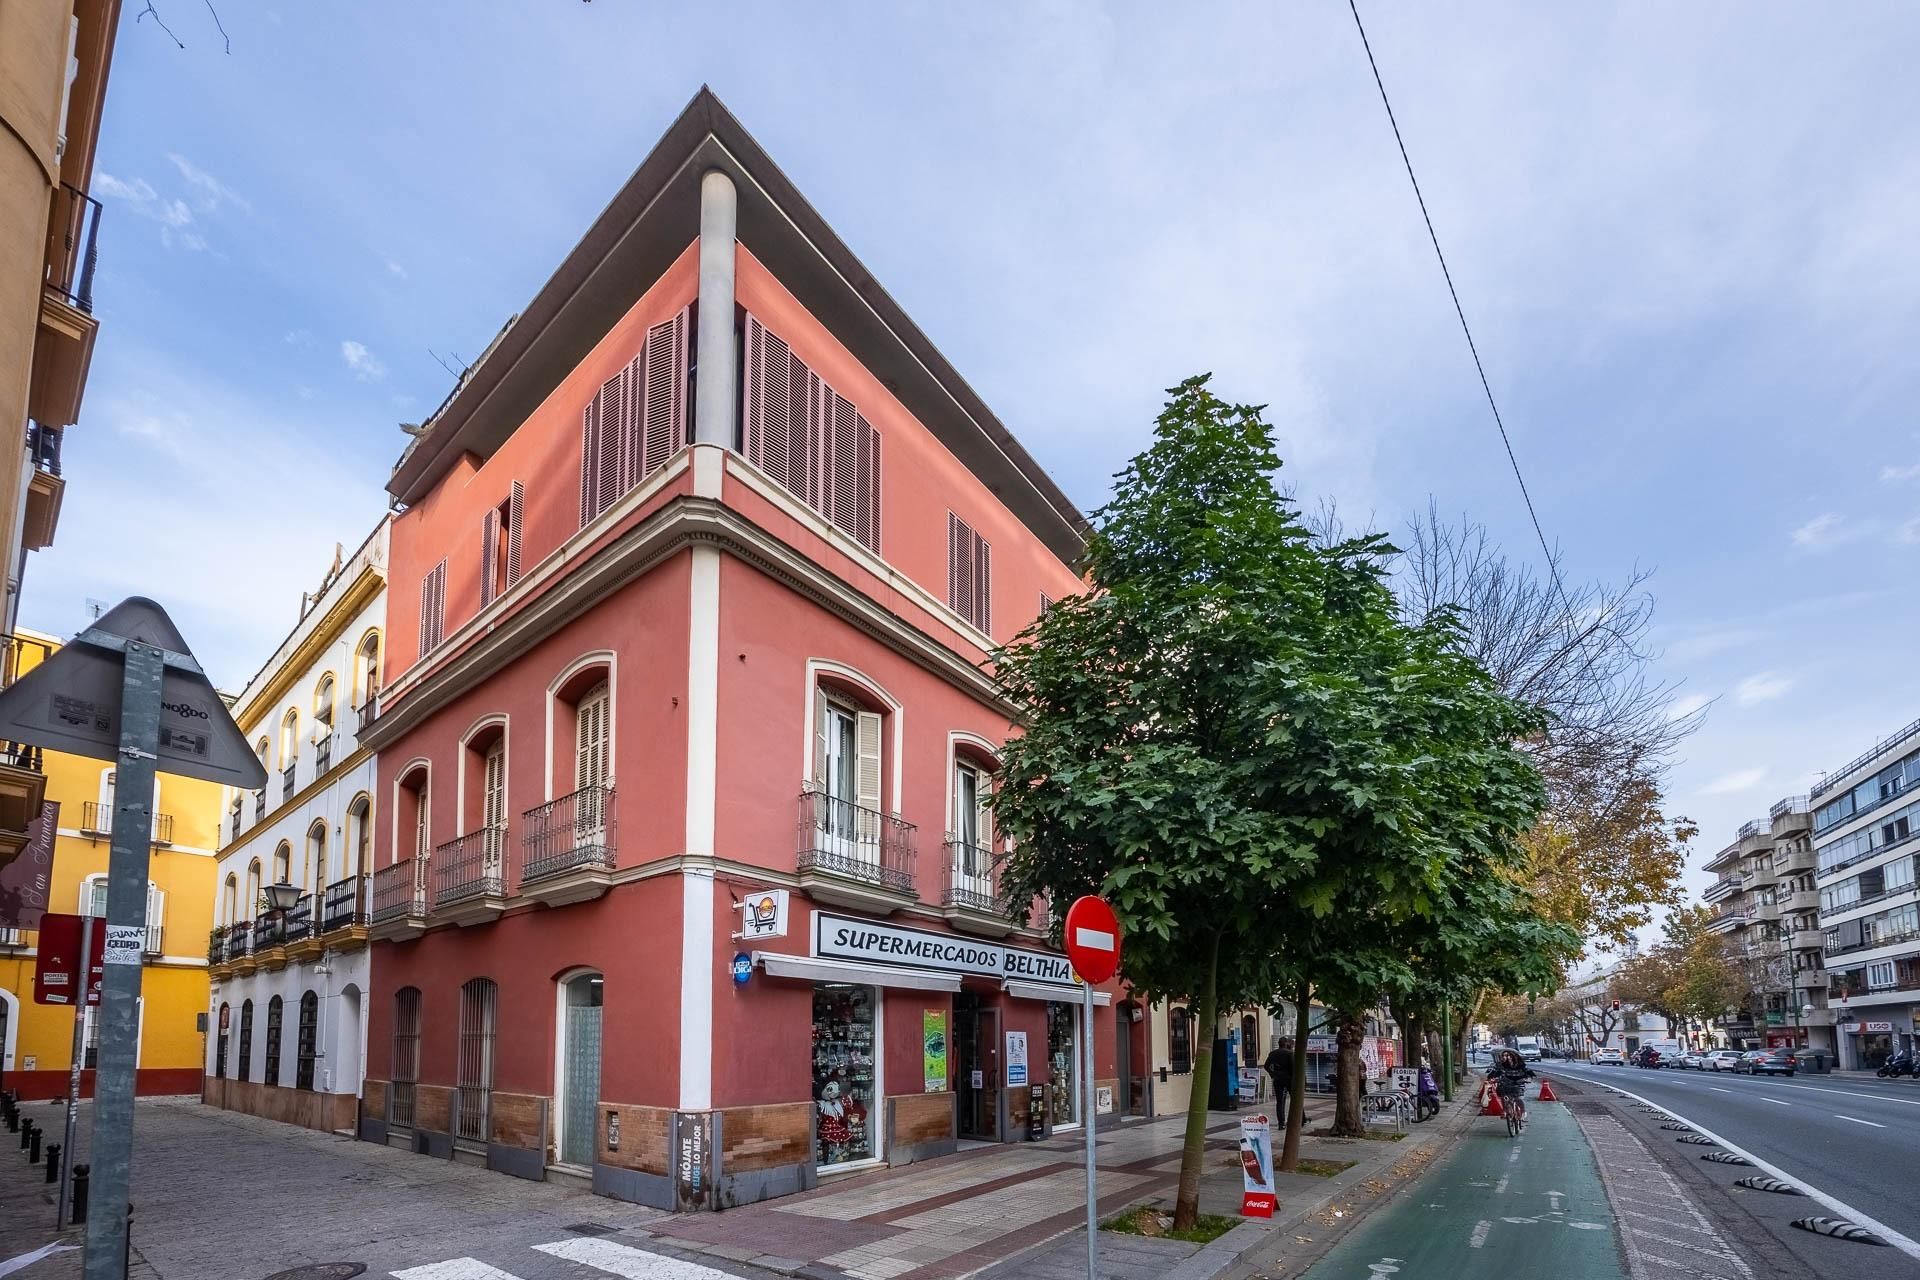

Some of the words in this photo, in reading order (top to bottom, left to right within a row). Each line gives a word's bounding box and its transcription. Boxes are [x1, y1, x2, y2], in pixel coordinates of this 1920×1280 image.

[27, 802, 56, 865] Francisco
[22, 873, 47, 905] San
[733, 965, 752, 974] DIGI
[834, 928, 997, 967] SUPERMERCADOS
[1003, 953, 1070, 980] BELTHIA
[693, 1125, 702, 1151] MEJOR
[680, 1138, 692, 1181] MÓJATE
[693, 1153, 701, 1164] LO
